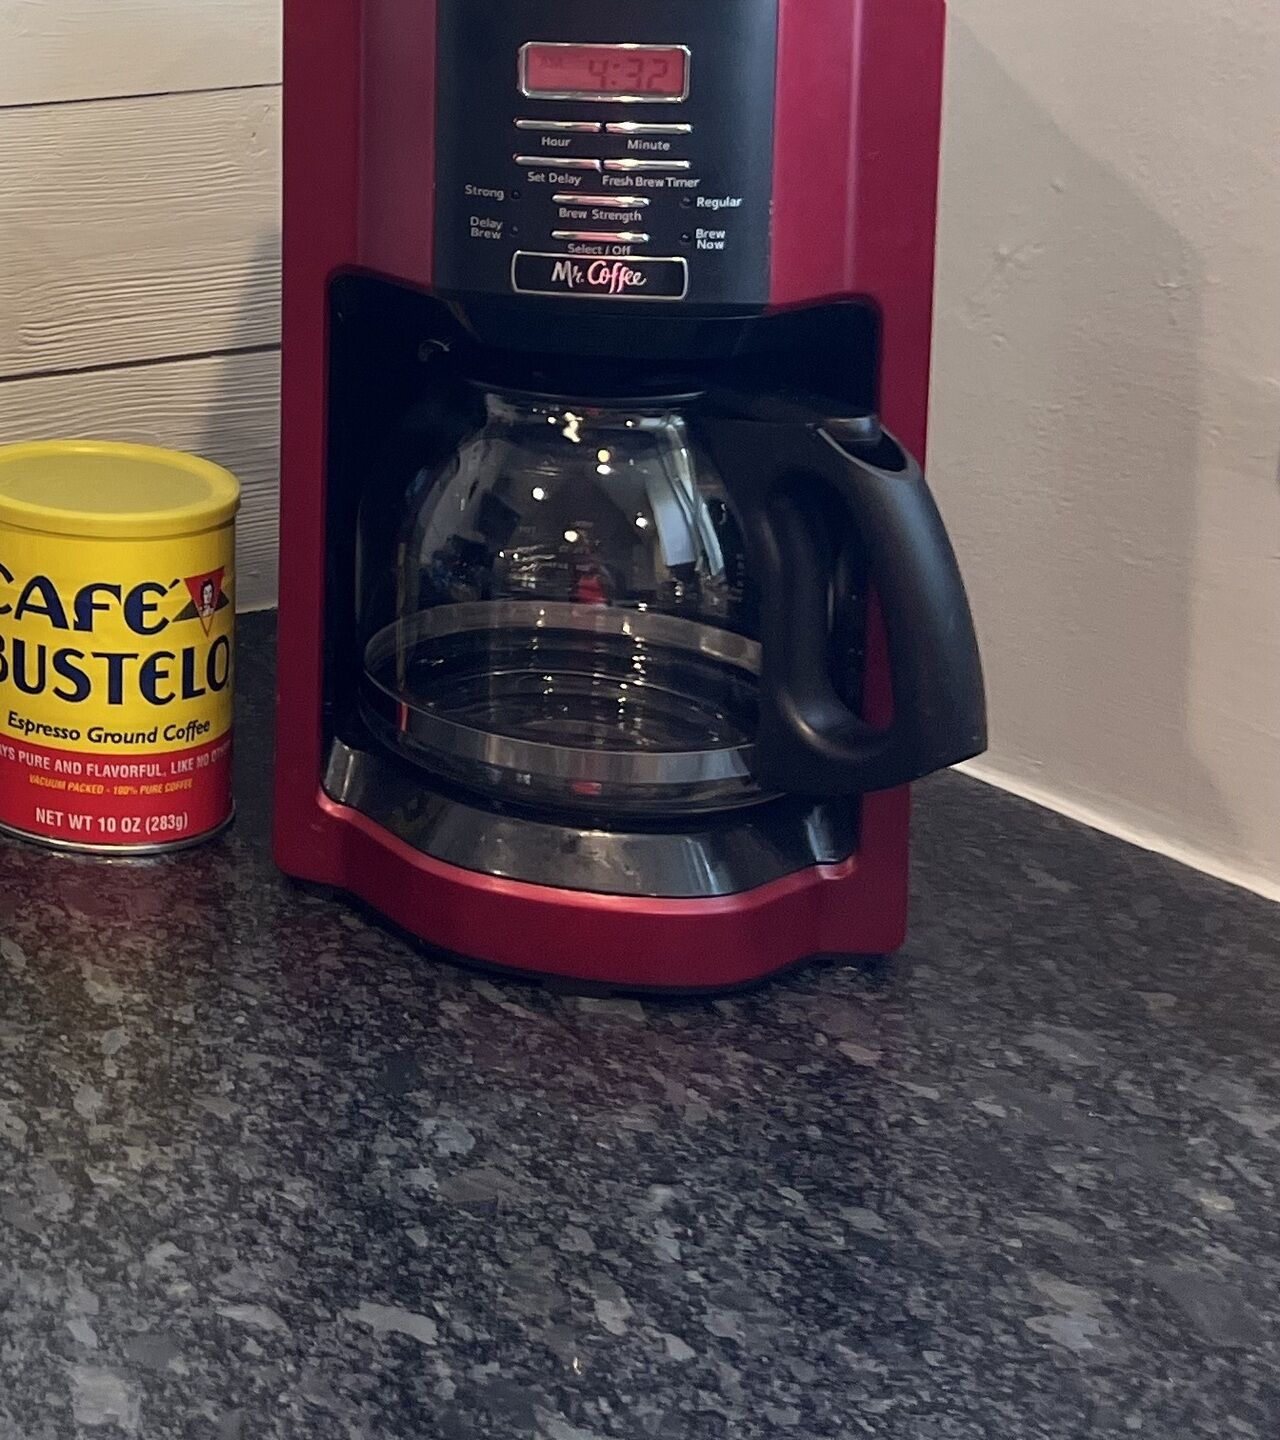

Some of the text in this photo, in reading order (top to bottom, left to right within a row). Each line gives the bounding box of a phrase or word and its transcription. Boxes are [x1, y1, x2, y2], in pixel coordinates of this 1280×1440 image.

[541, 136, 572, 148] Hour
[627, 139, 671, 152] Minute
[527, 172, 582, 186] Set Delay
[602, 175, 700, 188] Fresh Brew Timer
[465, 185, 505, 201] Strong
[696, 197, 742, 211] Regular
[469, 216, 503, 231] Delay
[558, 208, 642, 225] Brew Strength
[470, 227, 502, 241] Brew
[695, 229, 726, 240] Brew
[567, 243, 603, 256] Select
[612, 244, 631, 256] Off
[696, 239, 725, 250] Now
[551, 259, 647, 293] Mr. Coffee
[8, 711, 211, 745] Espresso Ground Coffee
[18, 750, 51, 771] PURE
[54, 759, 83, 776] AND
[170, 757, 195, 775] LIKE
[196, 753, 210, 769] NO
[29, 773, 66, 791] VACUUM
[67, 780, 105, 795] PACKED
[139, 782, 164, 795] PURE
[164, 777, 194, 794] COFFEE
[35, 806, 189, 835] NET WT 10 OZ (283g)
